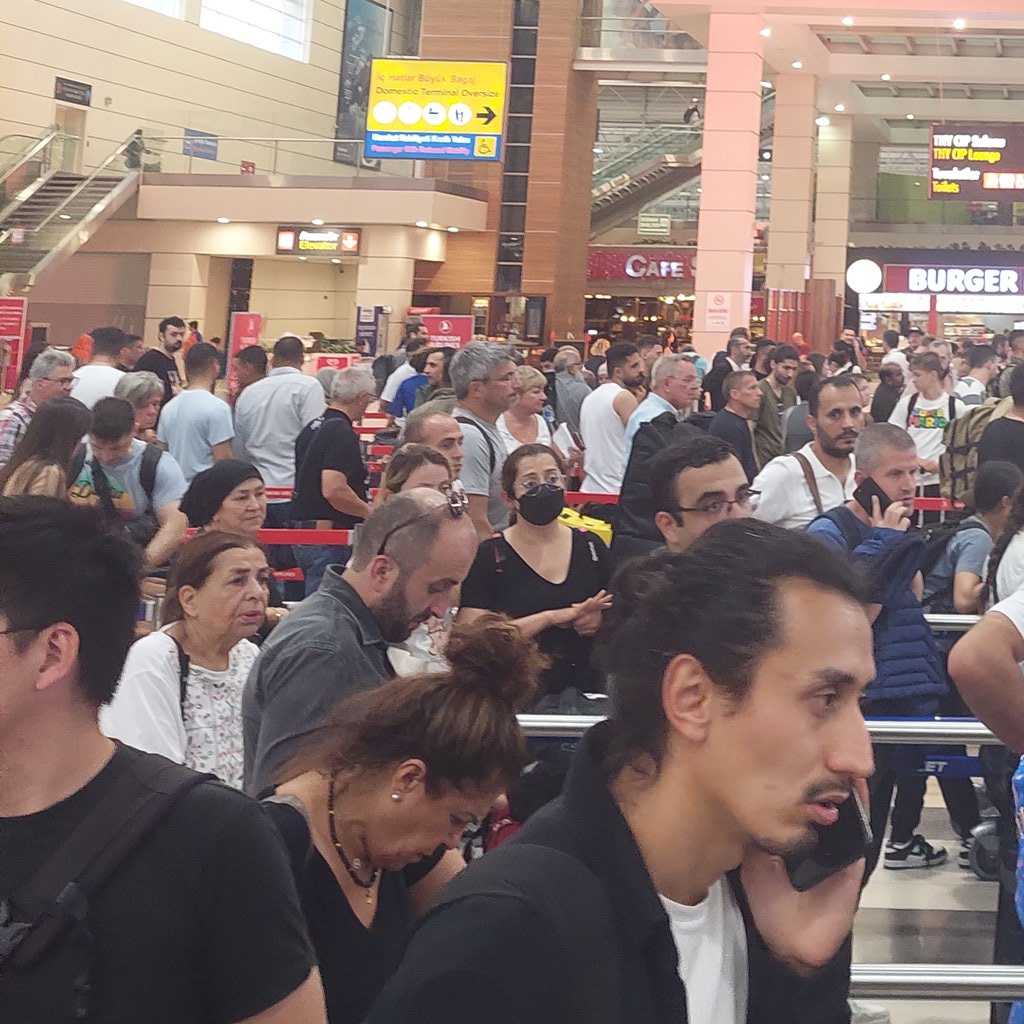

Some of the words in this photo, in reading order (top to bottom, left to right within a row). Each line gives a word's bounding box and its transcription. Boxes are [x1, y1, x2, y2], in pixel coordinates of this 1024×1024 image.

[421, 87, 458, 97] Terminal
[625, 254, 684, 278] CAFE
[908, 268, 1019, 293] BURGER
